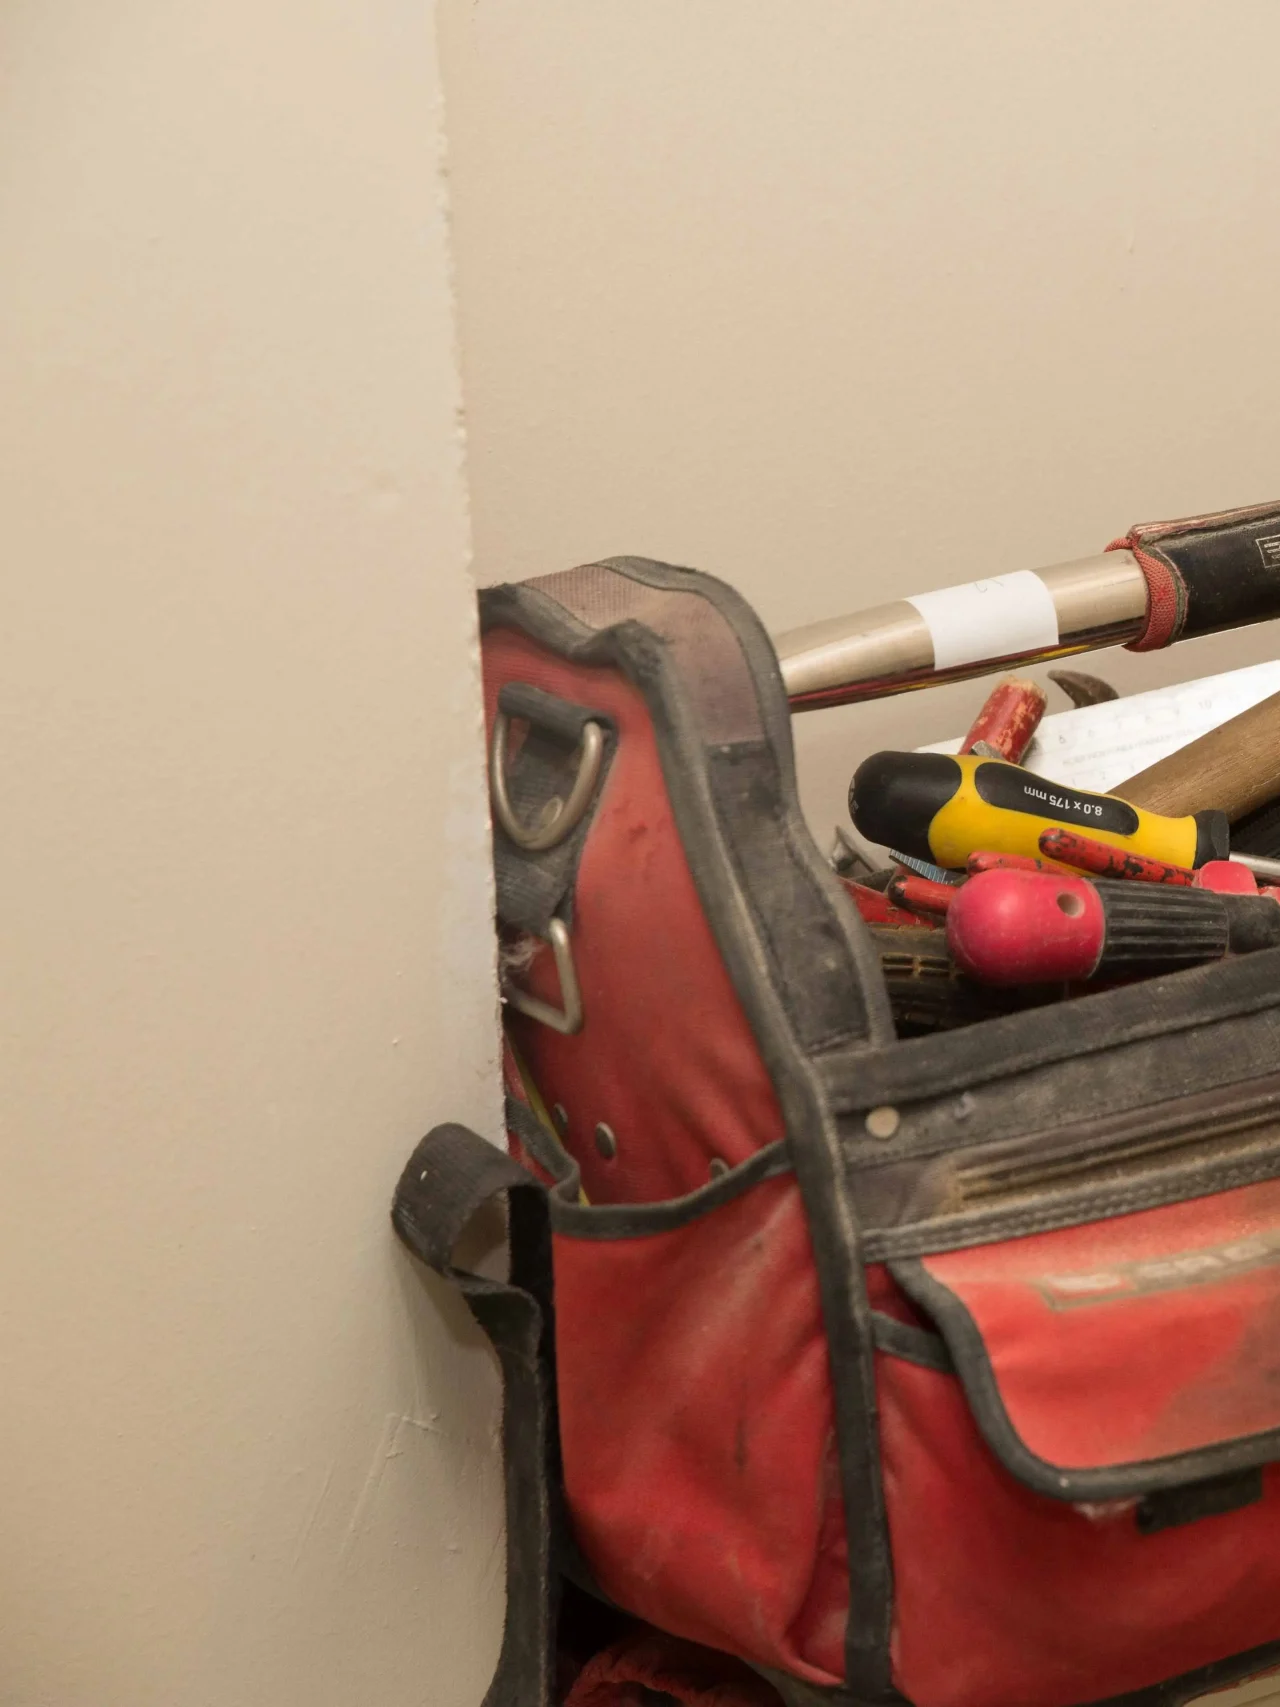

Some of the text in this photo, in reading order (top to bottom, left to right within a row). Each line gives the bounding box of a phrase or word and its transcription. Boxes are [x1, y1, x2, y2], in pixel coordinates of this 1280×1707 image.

[1023, 785, 1103, 817] 8.0 x 175 mm
